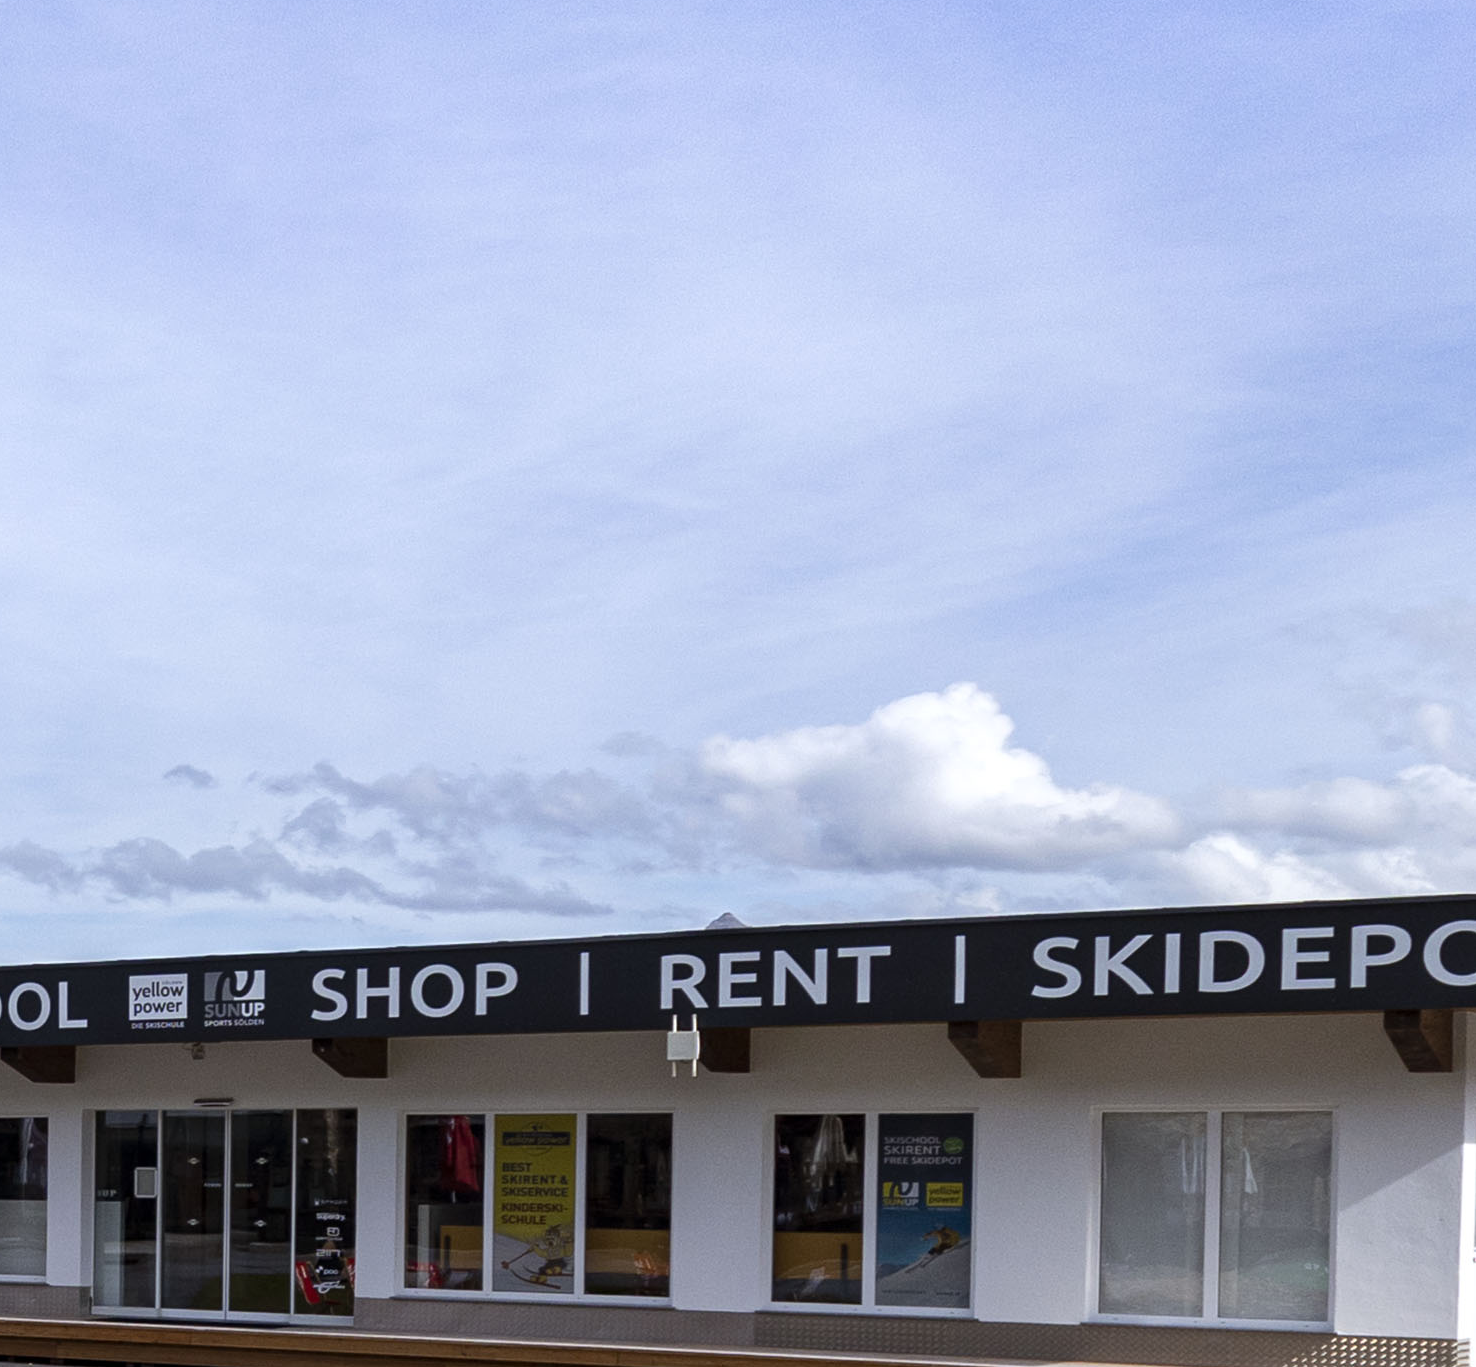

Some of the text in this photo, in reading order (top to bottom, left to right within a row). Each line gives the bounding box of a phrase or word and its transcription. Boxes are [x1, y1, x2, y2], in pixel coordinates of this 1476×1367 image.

[311, 963, 518, 1022] SHOP
[660, 946, 892, 1010] RENT
[132, 981, 184, 1001] yellow
[133, 1001, 183, 1017] power
[204, 1002, 265, 1018] SUNUP
[234, 1018, 265, 1026] SÖLDEN
[883, 1145, 942, 1155] SKIRENT
[883, 1156, 963, 1165] FREE SKIDEPOT
[502, 1162, 532, 1172] BEST
[501, 1175, 568, 1185] SKIRENT &
[501, 1187, 569, 1197] SKISERVICE
[501, 1202, 568, 1212] KINDERSKI-
[501, 1215, 547, 1225] SCHULE
